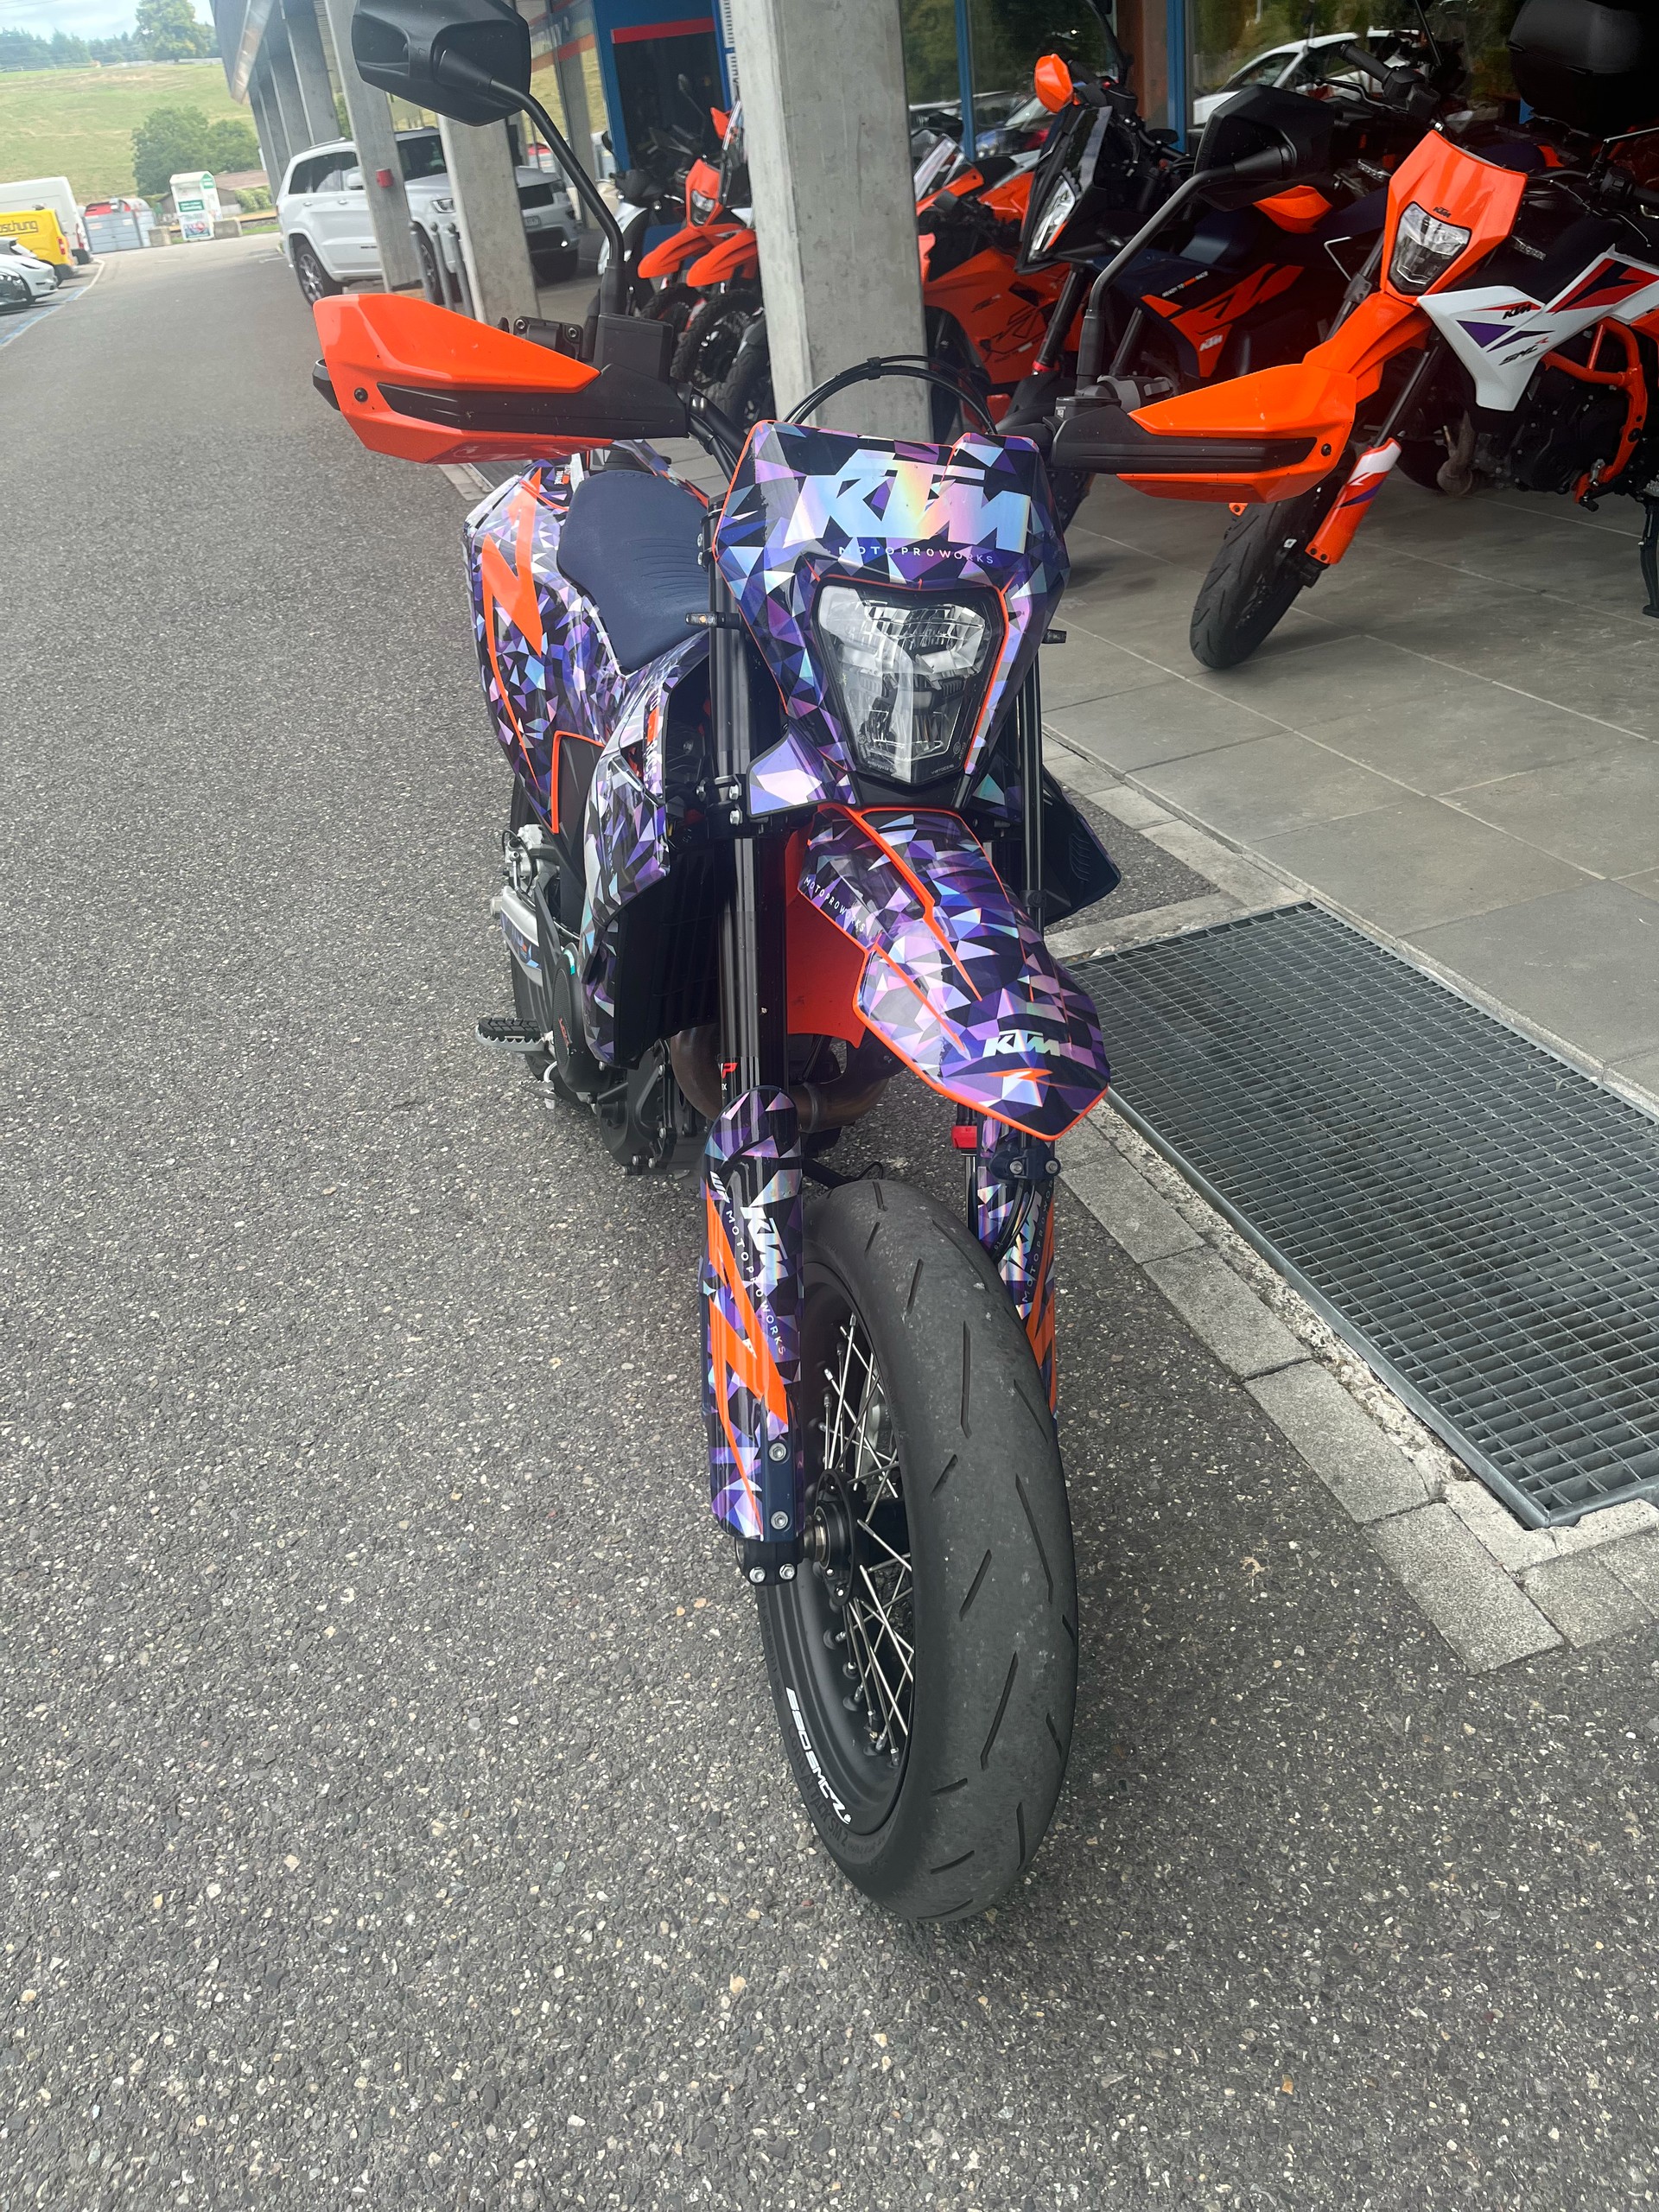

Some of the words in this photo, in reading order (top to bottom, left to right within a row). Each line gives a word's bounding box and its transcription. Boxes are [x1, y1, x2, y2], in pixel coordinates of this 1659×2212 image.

[1433, 207, 1452, 218] KTM
[1502, 304, 1532, 321] KTM
[783, 448, 1031, 554] KTM
[838, 546, 994, 564] MOTOPROWORKS
[804, 876, 866, 932] MOTOPROWORKS
[982, 1028, 1061, 1058] KTM
[740, 1206, 790, 1283] KTM
[725, 1210, 786, 1356] MOTOPROWORKS
